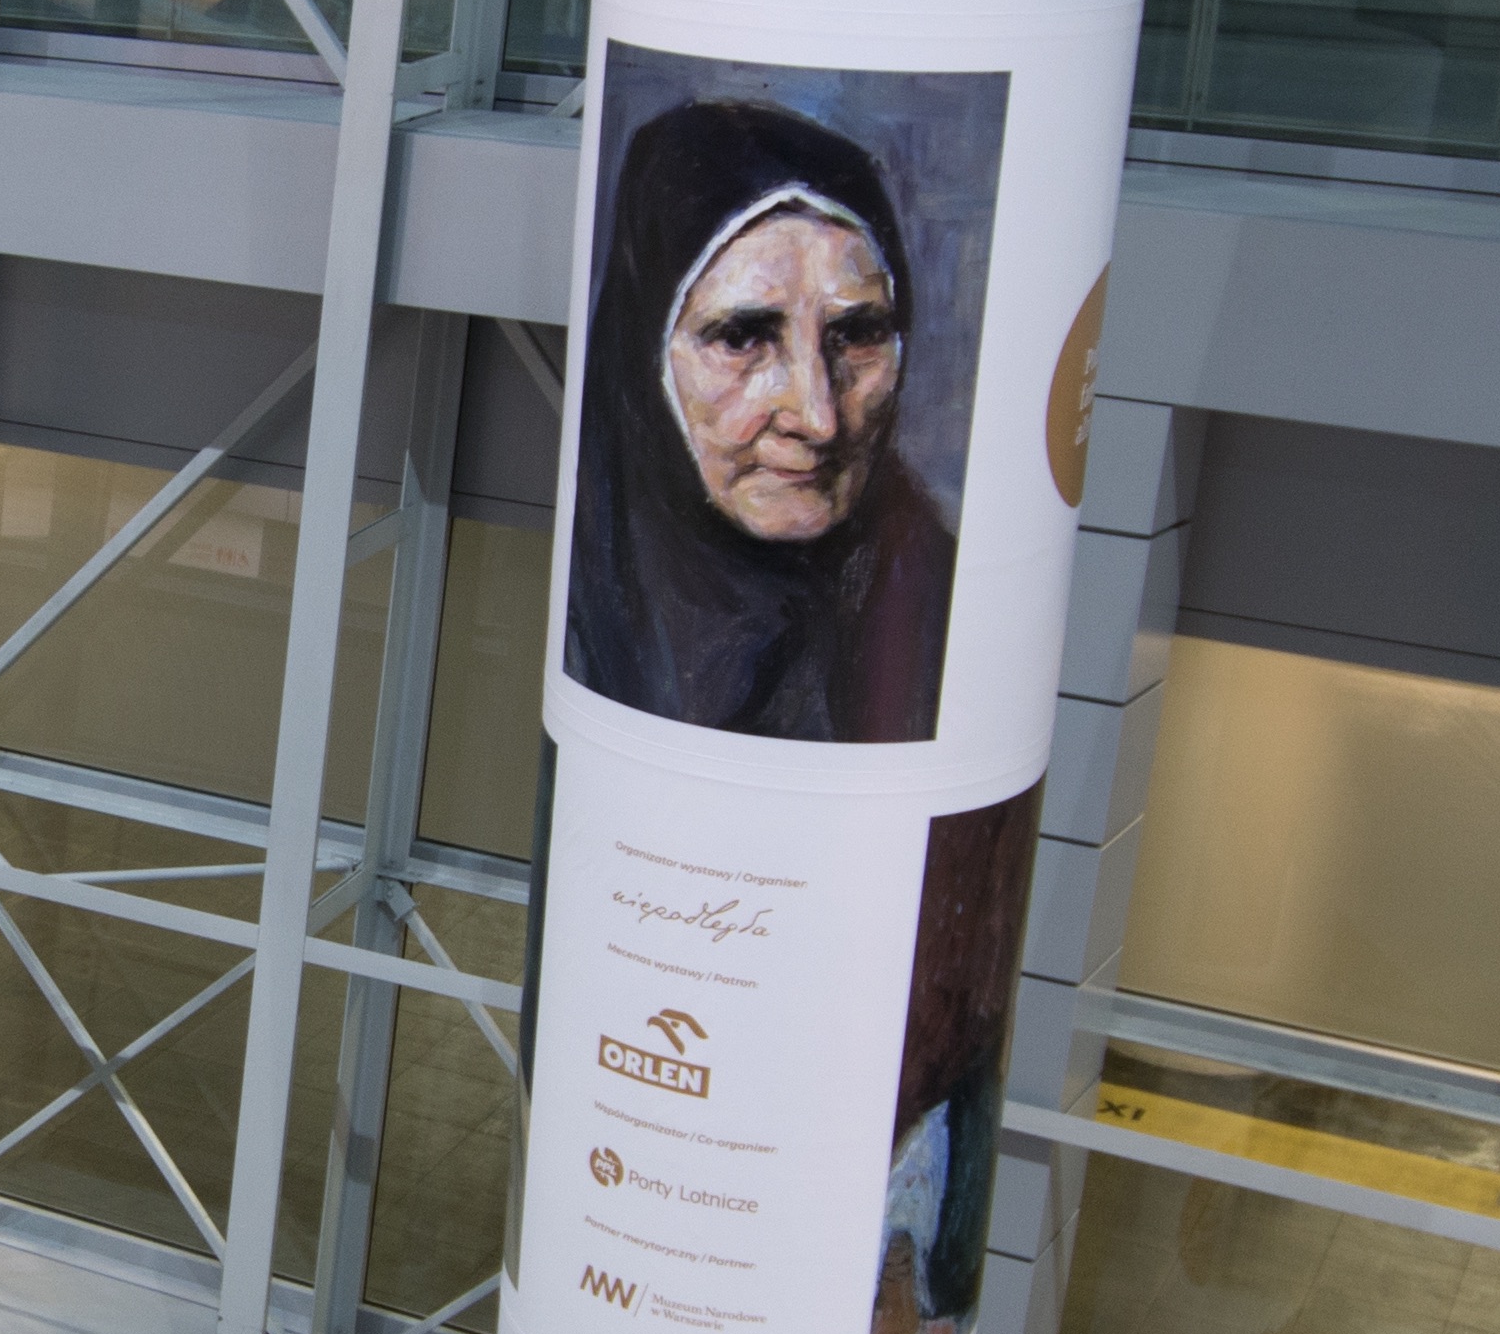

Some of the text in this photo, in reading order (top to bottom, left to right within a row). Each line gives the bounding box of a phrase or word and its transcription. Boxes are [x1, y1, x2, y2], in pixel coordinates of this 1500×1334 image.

[615, 840, 679, 870] Organizator
[680, 860, 734, 882] wystawy
[607, 941, 654, 965] Mecenas
[654, 959, 705, 981] wystawy
[602, 1043, 703, 1093] ORLEN
[593, 1099, 689, 1141] Współorganizator
[628, 1170, 674, 1199] Porty
[679, 1183, 759, 1213] Lotnicze
[584, 1214, 622, 1238] Partner
[622, 1229, 699, 1263] merytoryczny
[650, 1306, 725, 1332] w Warszawie
[652, 1292, 703, 1315] Muzeum
[705, 1304, 768, 1326] Narodowe
